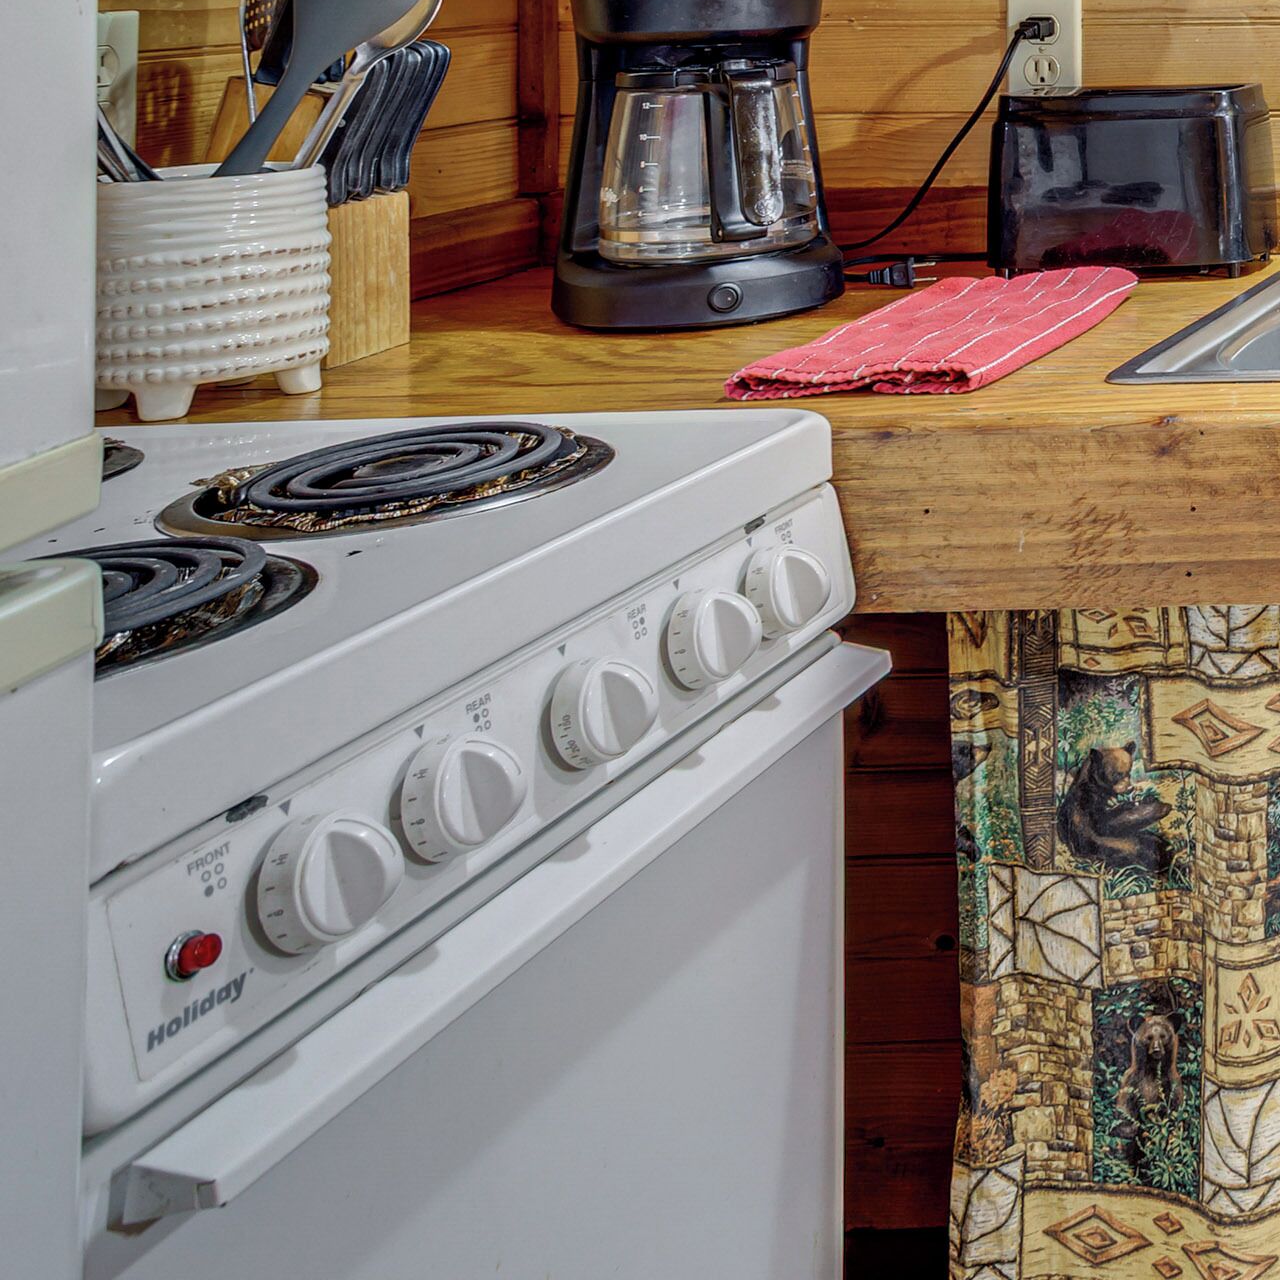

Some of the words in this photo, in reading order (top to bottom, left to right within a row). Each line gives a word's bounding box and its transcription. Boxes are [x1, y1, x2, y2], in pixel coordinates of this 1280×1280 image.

[465, 693, 492, 715] REAR
[186, 841, 232, 876] FRONT
[147, 971, 248, 1053] Holiday
